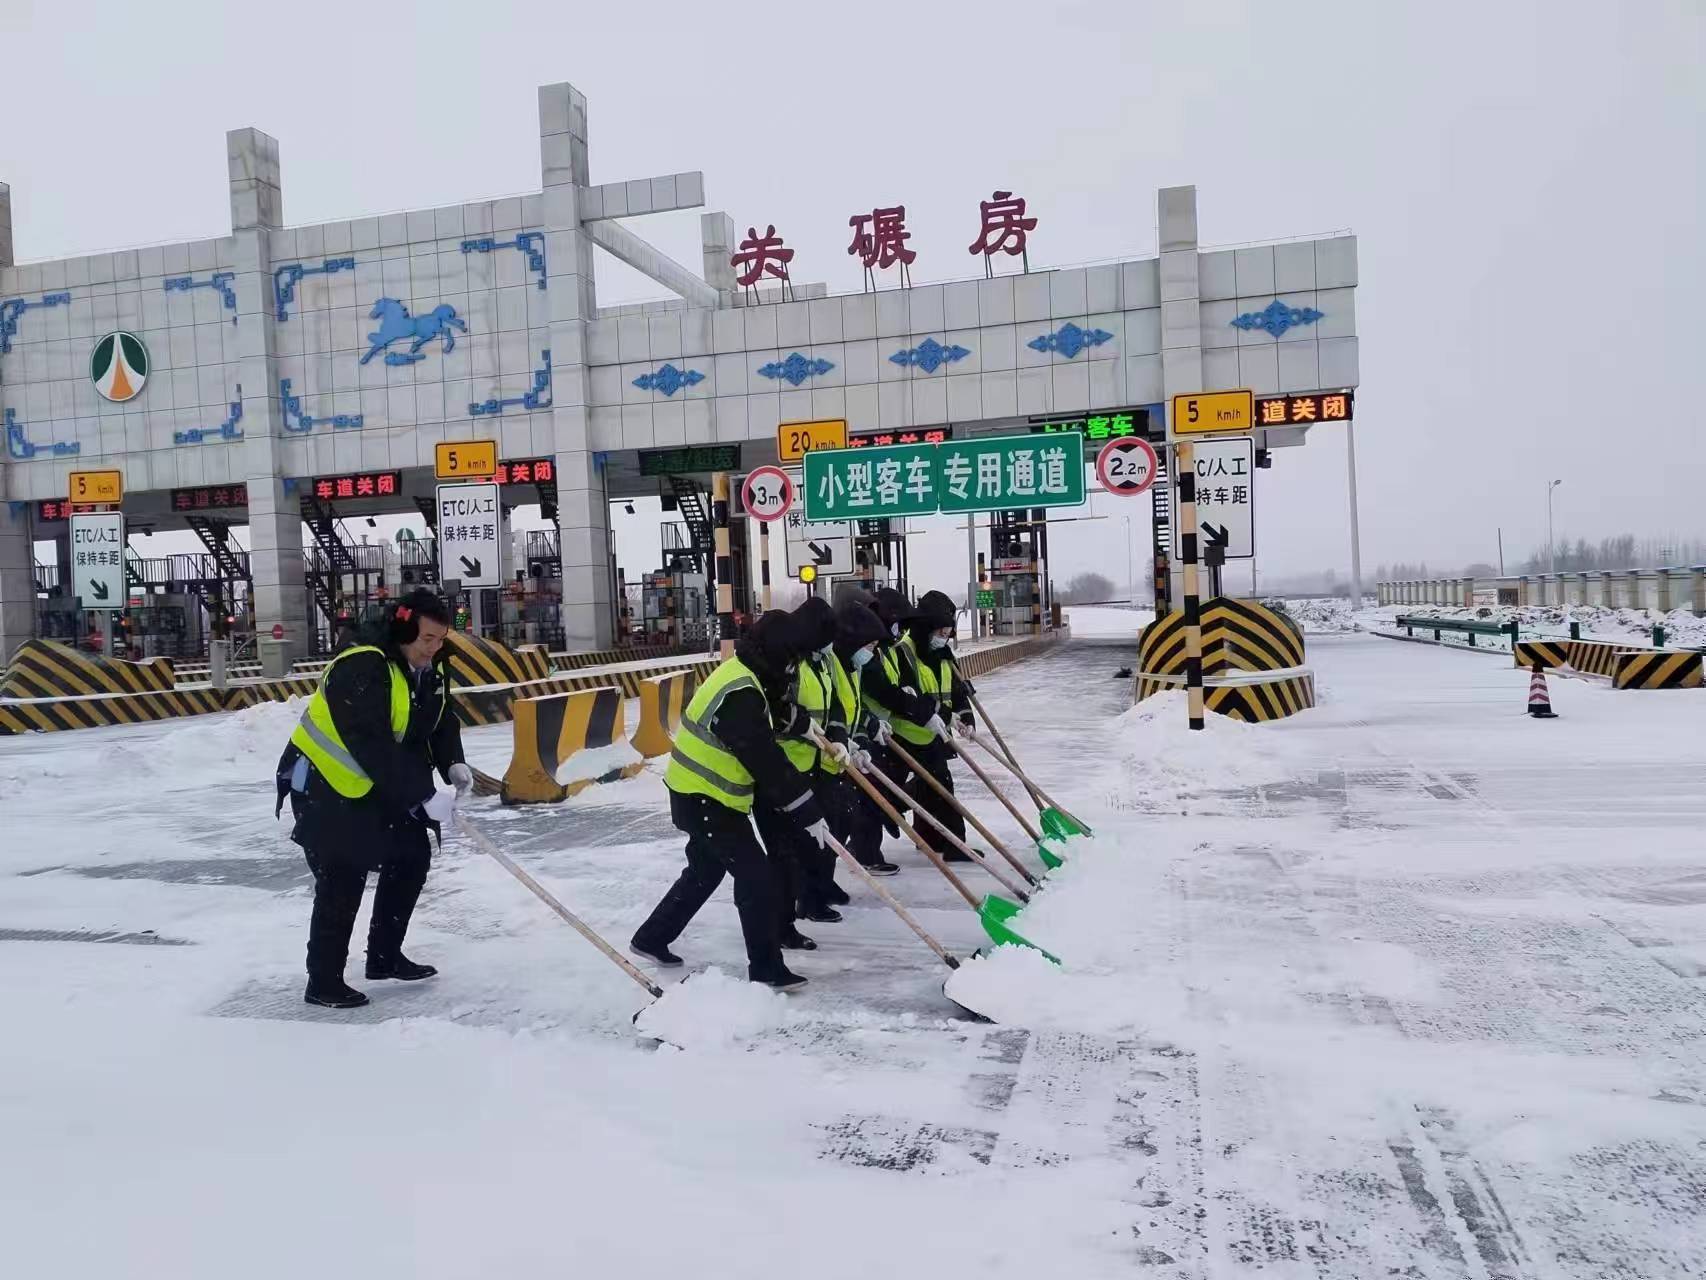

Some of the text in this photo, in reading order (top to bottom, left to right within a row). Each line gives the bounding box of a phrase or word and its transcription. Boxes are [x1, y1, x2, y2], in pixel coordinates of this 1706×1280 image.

[730, 191, 1038, 286] 关碾房
[1187, 400, 1199, 422] 5
[1255, 395, 1346, 423] 道关闭
[790, 431, 811, 453] 20
[448, 450, 458, 471] 5
[1110, 456, 1147, 477] 2.2m
[1194, 457, 1247, 477] C/人工
[474, 461, 552, 484] 道关闭
[818, 447, 1068, 510] 小型客车 专用通道
[78, 476, 87, 496] 5
[317, 474, 394, 498] 车道关闭
[757, 486, 779, 506] 3m
[1196, 486, 1248, 506] 持车距
[442, 498, 495, 517] ETC/人工
[75, 527, 119, 544] ETC/人工
[444, 523, 495, 542] 保持车距
[76, 550, 120, 567] 保持车距
